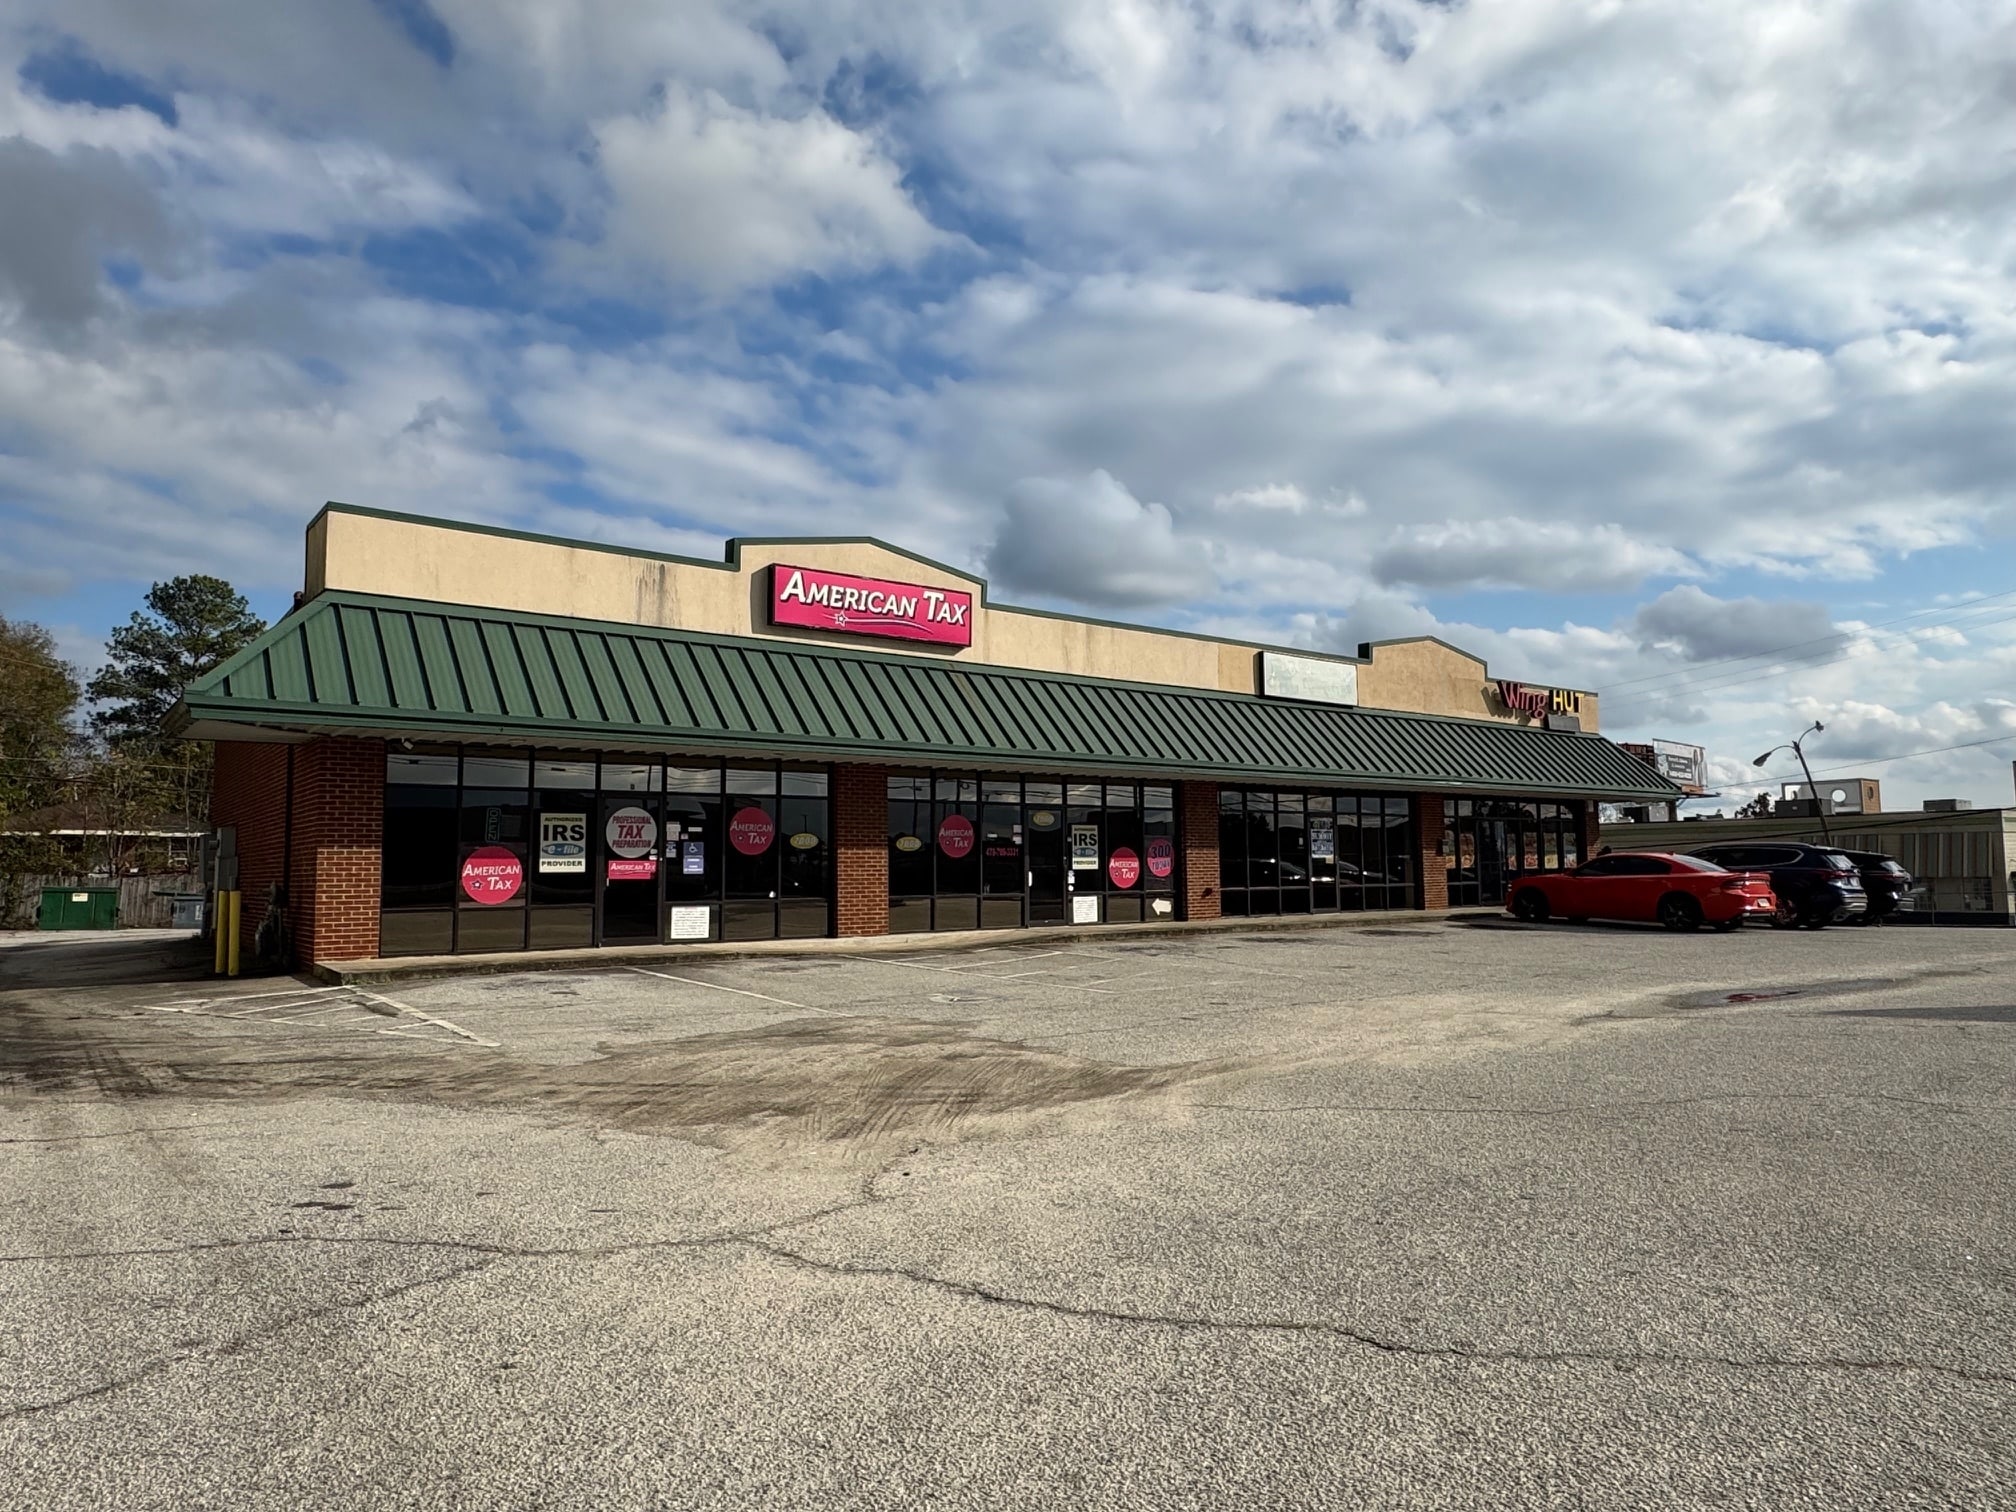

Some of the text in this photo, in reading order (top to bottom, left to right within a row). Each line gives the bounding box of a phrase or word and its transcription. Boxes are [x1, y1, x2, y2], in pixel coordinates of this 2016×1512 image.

[780, 571, 968, 625] AMERICAN TAX
[1499, 680, 1585, 719] Wing HUT
[543, 824, 584, 841] IRS
[618, 825, 645, 839] TAX
[730, 821, 773, 832] AMERICAN
[939, 827, 973, 837] AMERICAN
[748, 833, 767, 844] TAX
[953, 837, 968, 848] TAX
[1074, 833, 1097, 846] IRS
[462, 864, 520, 877] AMERICAN
[1121, 868, 1135, 878] TAX
[487, 877, 513, 891] TAX
